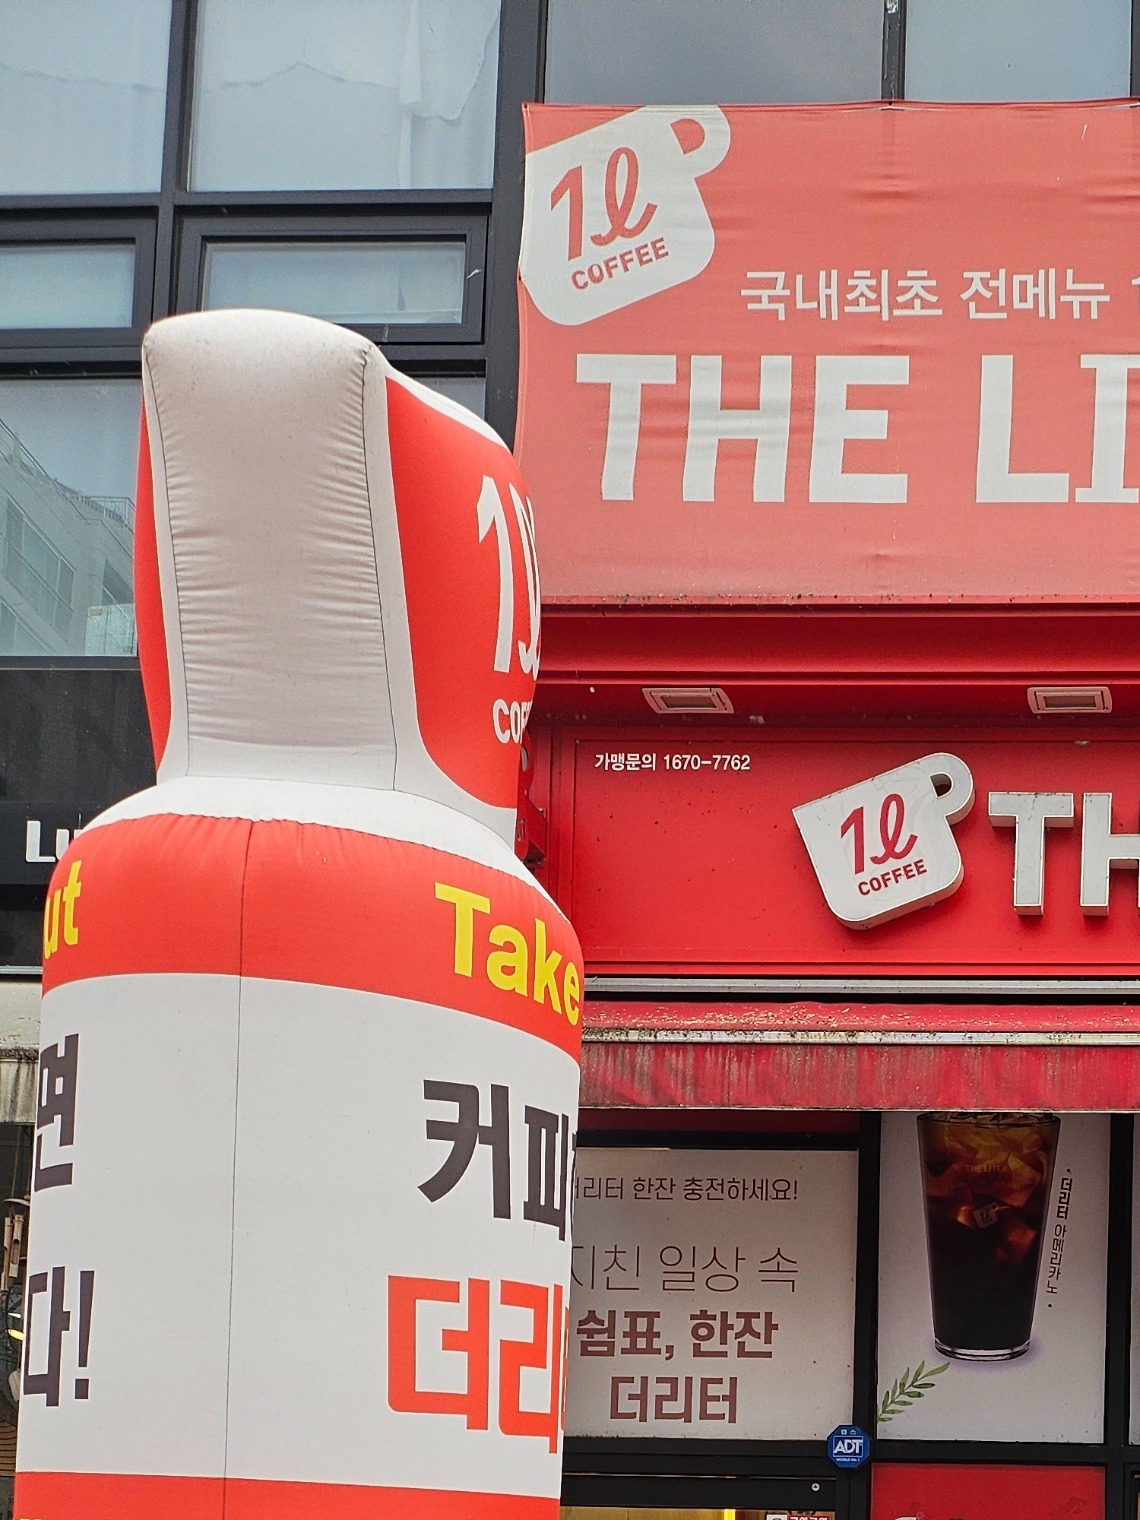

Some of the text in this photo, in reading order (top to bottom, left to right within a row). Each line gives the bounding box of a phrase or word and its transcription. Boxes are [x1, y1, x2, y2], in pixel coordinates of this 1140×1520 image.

[570, 237, 669, 291] COFFEE
[740, 268, 943, 321] 국내최초
[960, 267, 1110, 320] 전메뉴
[576, 353, 910, 503] THE
[593, 753, 751, 772] 가맹문의 1670-7762
[856, 858, 929, 897] COFFEE
[434, 881, 581, 1027] Take
[417, 1078, 576, 1243] 커피
[632, 1176, 677, 1201] 한잔
[682, 1177, 798, 1202] 충전하세요!
[1045, 1177, 1074, 1295] 더리터 아메리카노
[571, 1244, 800, 1293] 지친 일상 속
[576, 1309, 779, 1361] 쉼표, 한잔
[387, 1274, 569, 1455] 더리
[609, 1375, 738, 1425] 더리터
[833, 1439, 863, 1454] ADT
